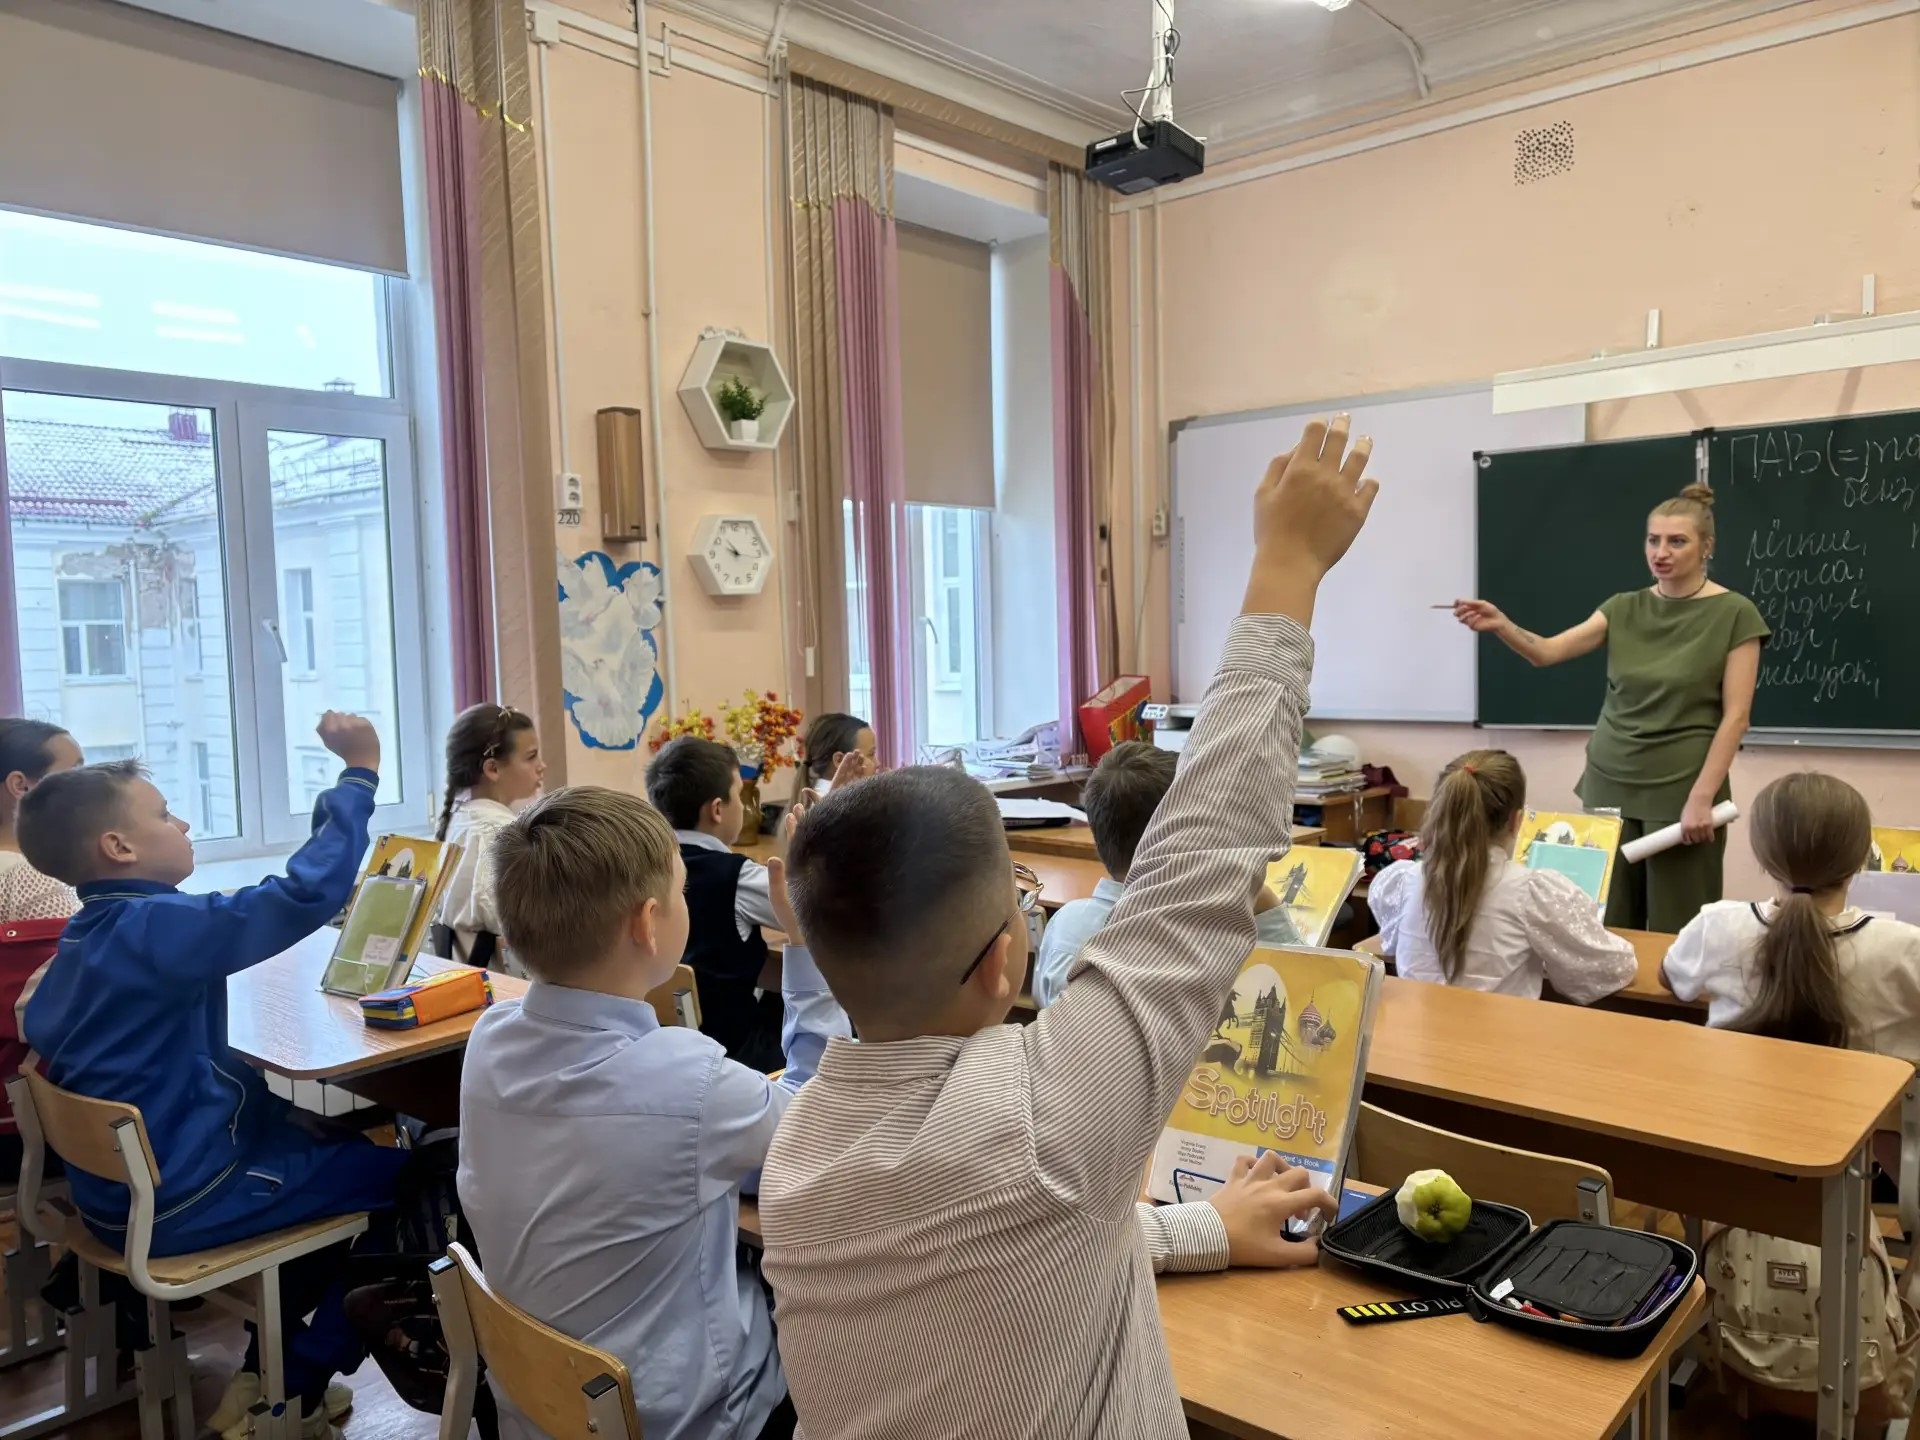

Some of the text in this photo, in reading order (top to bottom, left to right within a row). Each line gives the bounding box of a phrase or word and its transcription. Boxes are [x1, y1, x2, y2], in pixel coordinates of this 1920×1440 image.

[557, 511, 580, 525] 220
[1184, 1067, 1326, 1144] Spotlight
[1400, 1297, 1464, 1314] PILOT
